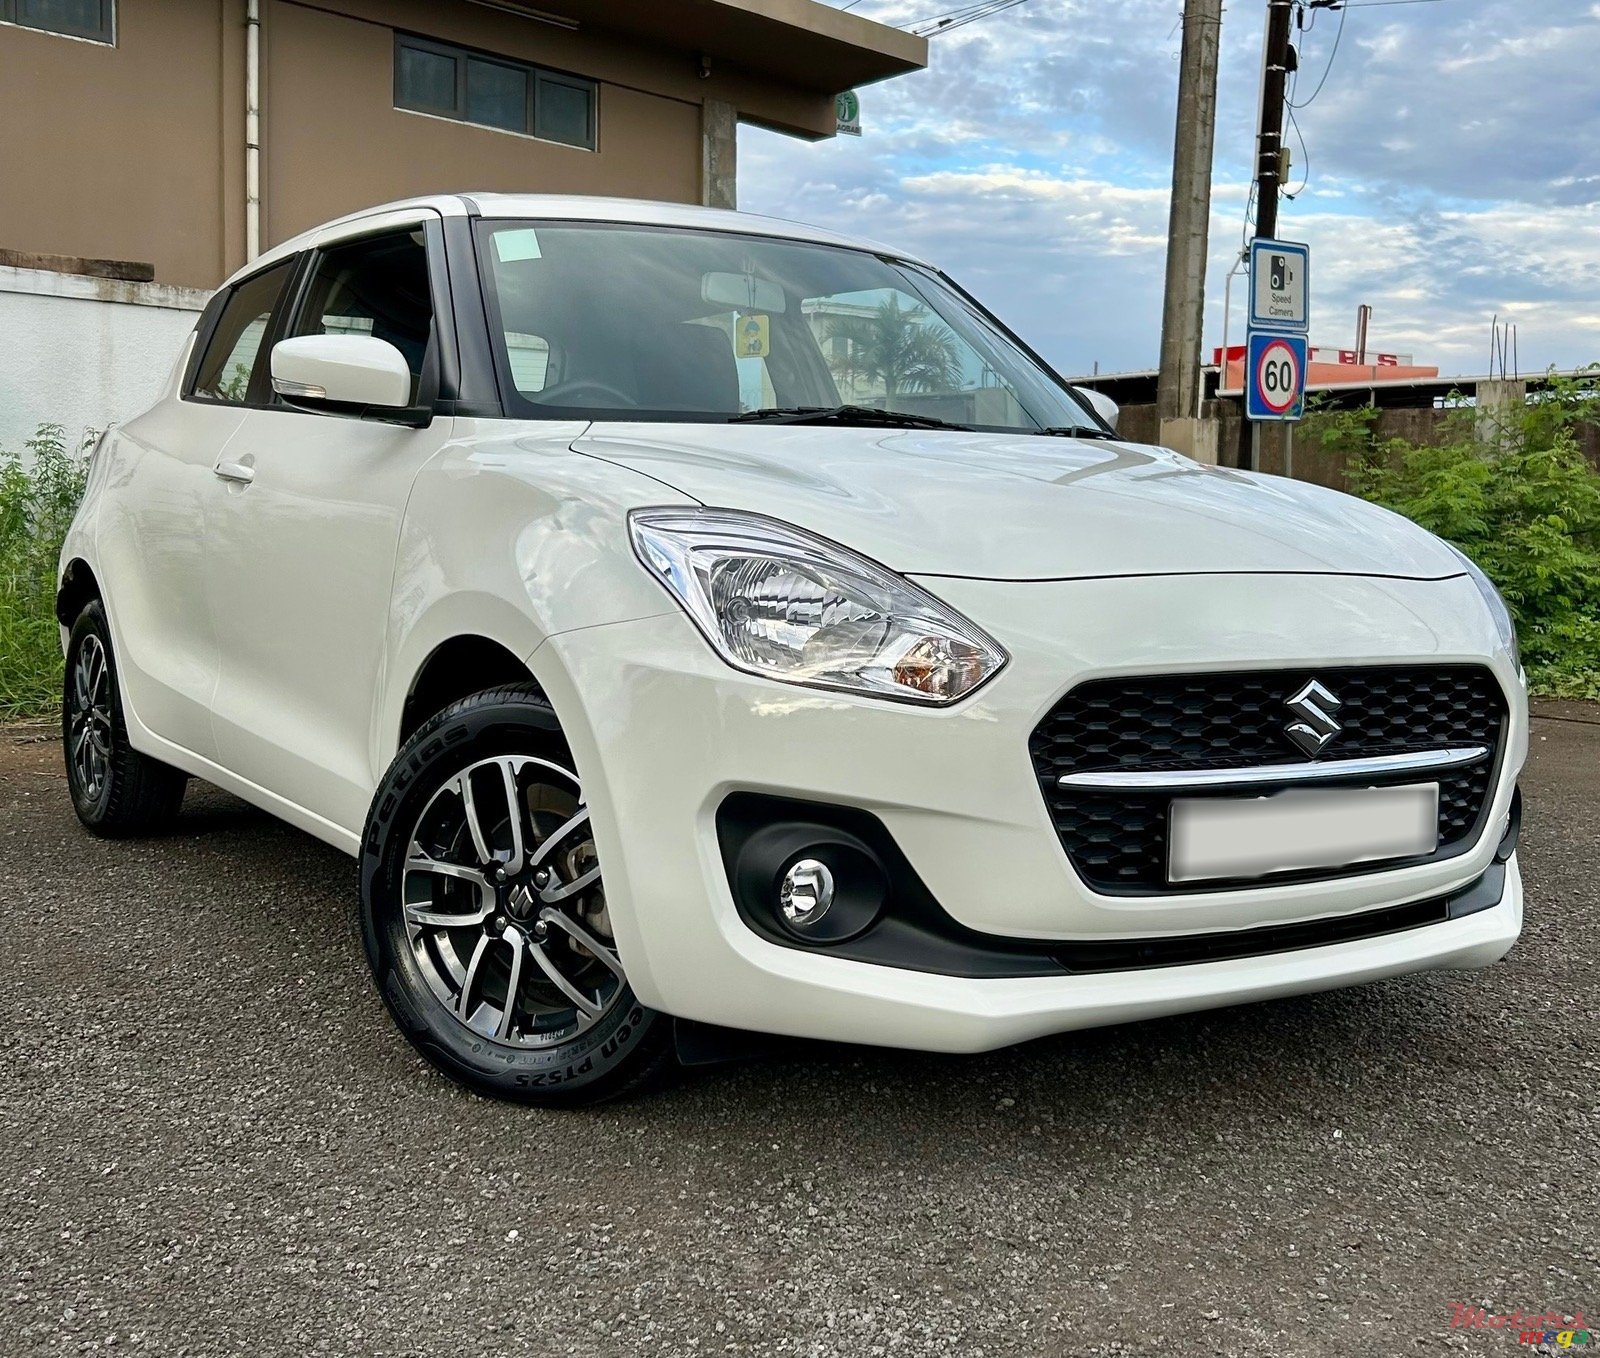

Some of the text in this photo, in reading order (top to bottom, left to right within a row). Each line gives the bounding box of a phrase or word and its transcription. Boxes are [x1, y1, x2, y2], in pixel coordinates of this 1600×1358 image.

[1271, 292, 1292, 305] Speed
[1269, 306, 1293, 317] Camera
[1264, 360, 1292, 392] 60
[366, 723, 468, 857] Petlas
